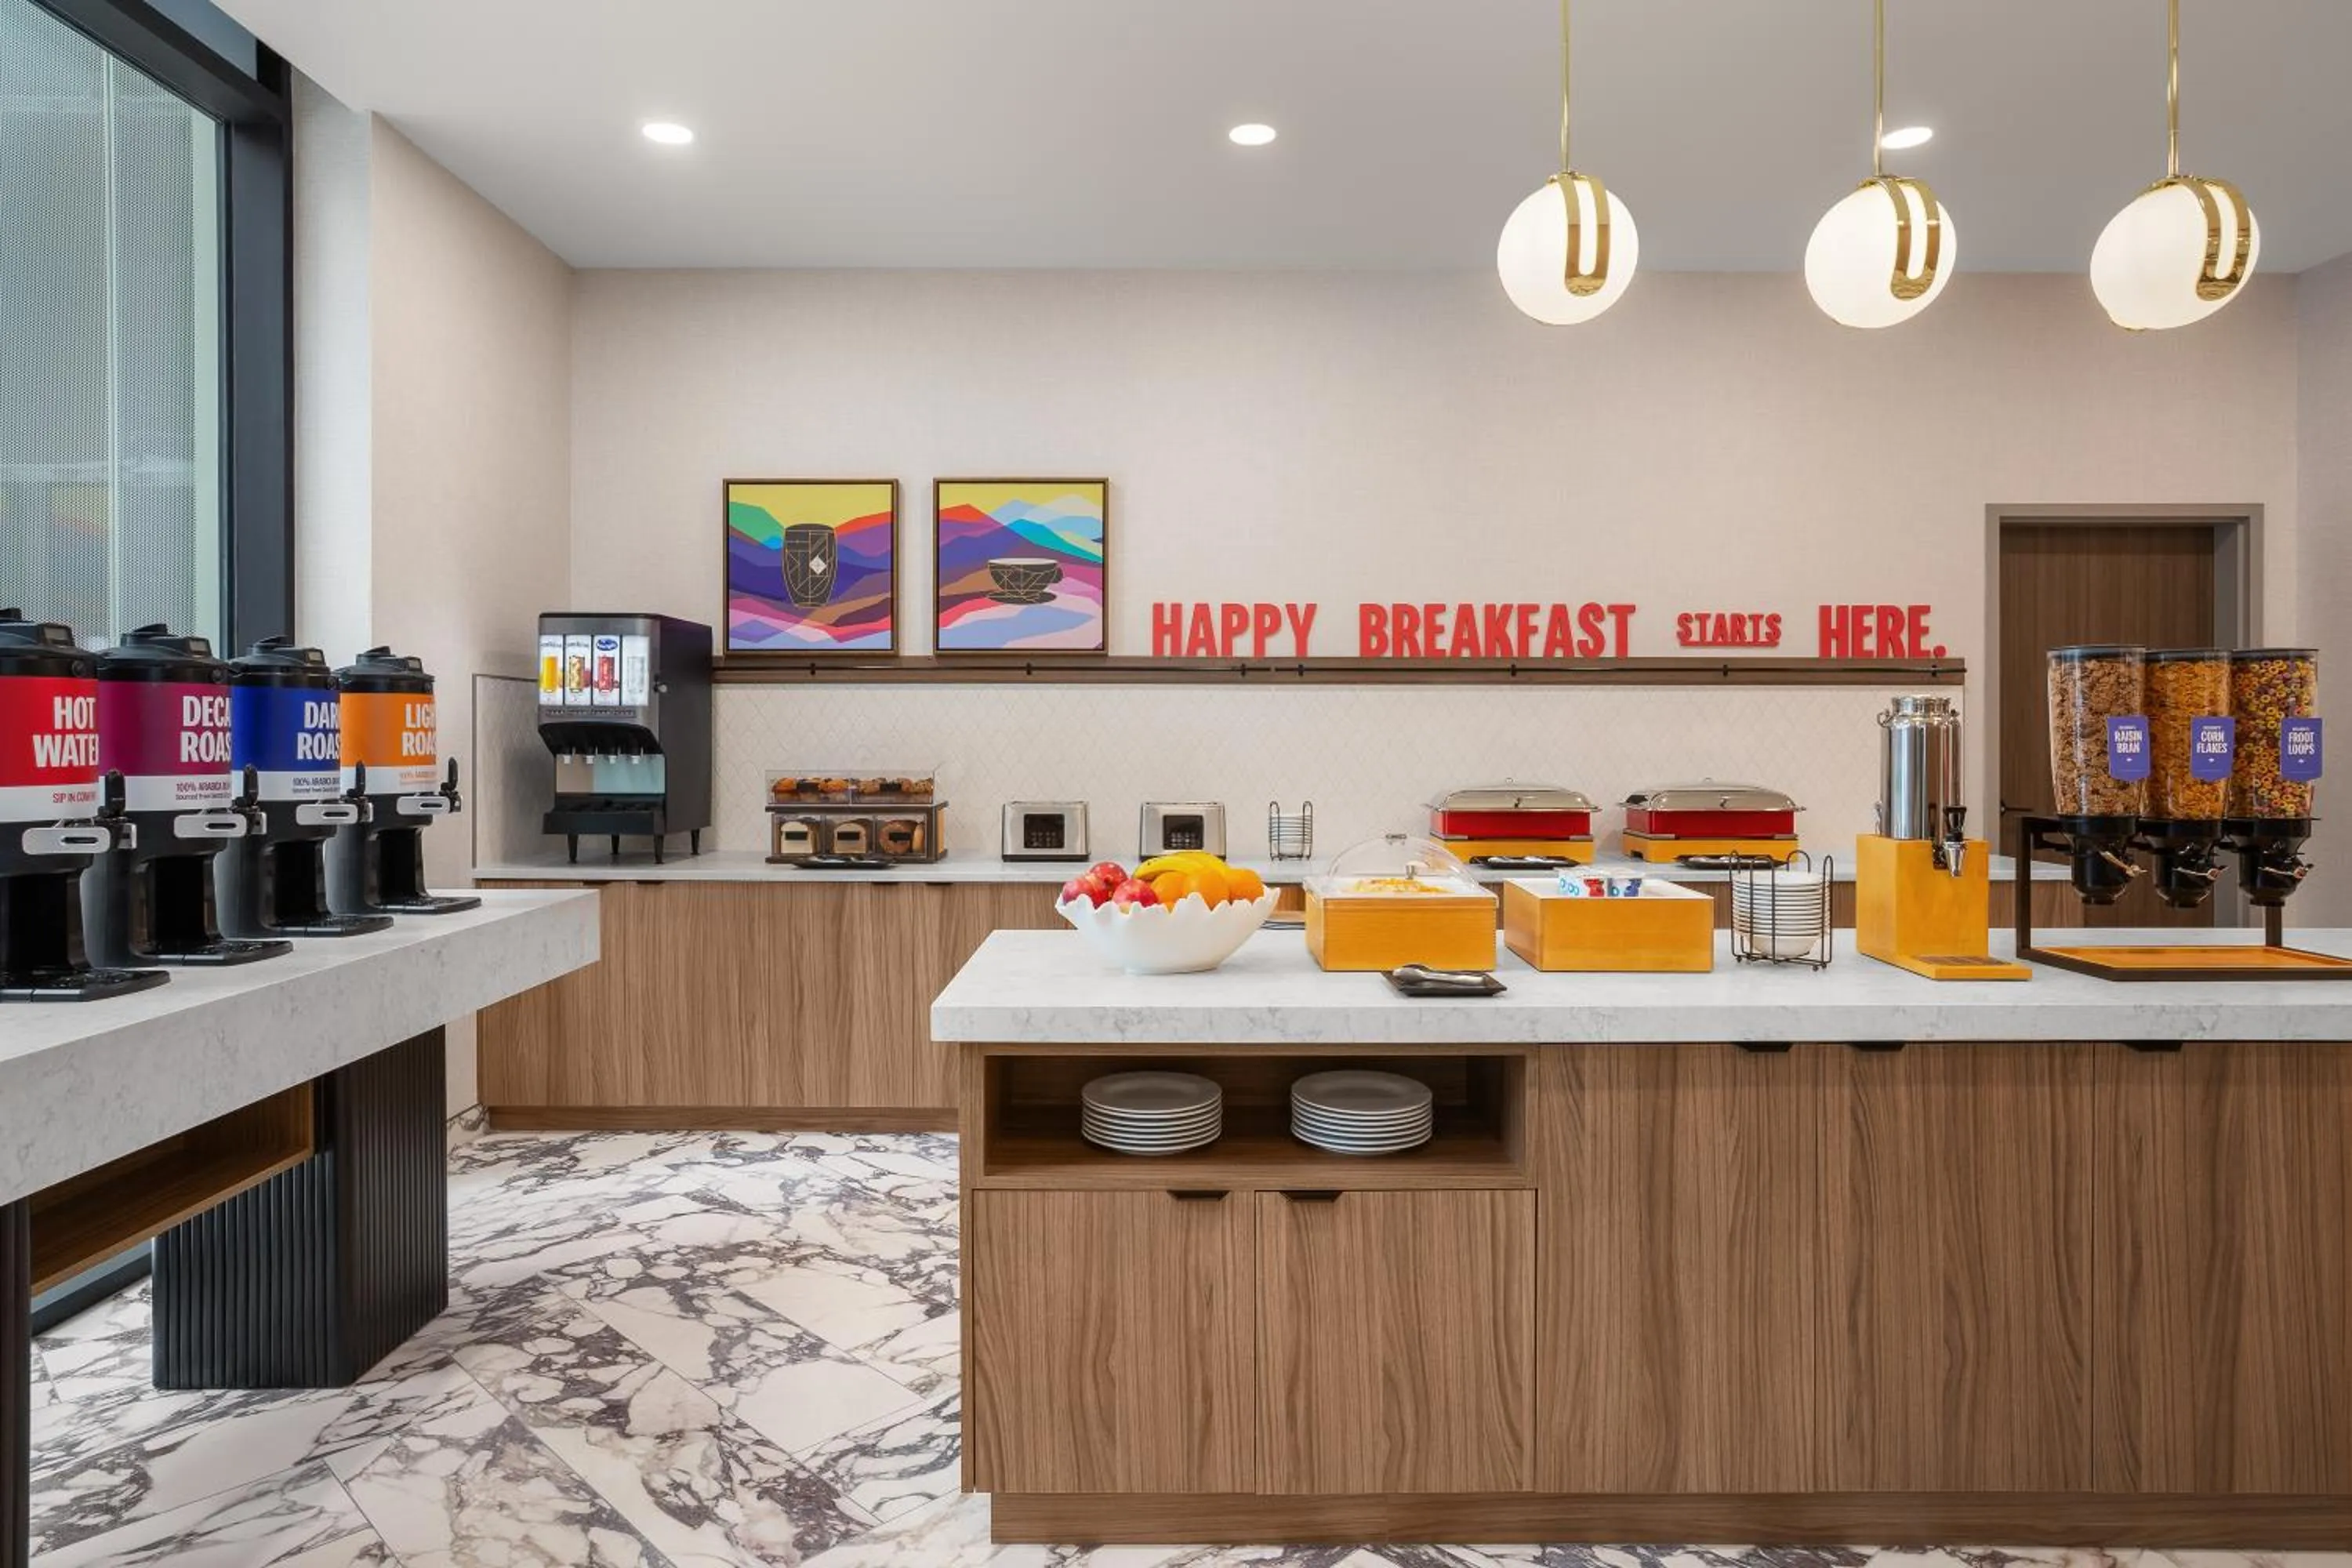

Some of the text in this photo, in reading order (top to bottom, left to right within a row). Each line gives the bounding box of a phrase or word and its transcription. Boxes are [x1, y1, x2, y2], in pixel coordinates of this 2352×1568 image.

[1152, 603, 1947, 659] HAPPY BREAKFAST STARTS HERE.
[53, 695, 96, 730] HOT
[2114, 730, 2143, 742] RAISIN
[2201, 731, 2225, 742] CORN
[2288, 731, 2315, 743] FROOT
[2116, 742, 2140, 753] BRAN
[2196, 742, 2228, 753] FLAKES
[2288, 743, 2315, 755] LOOPS
